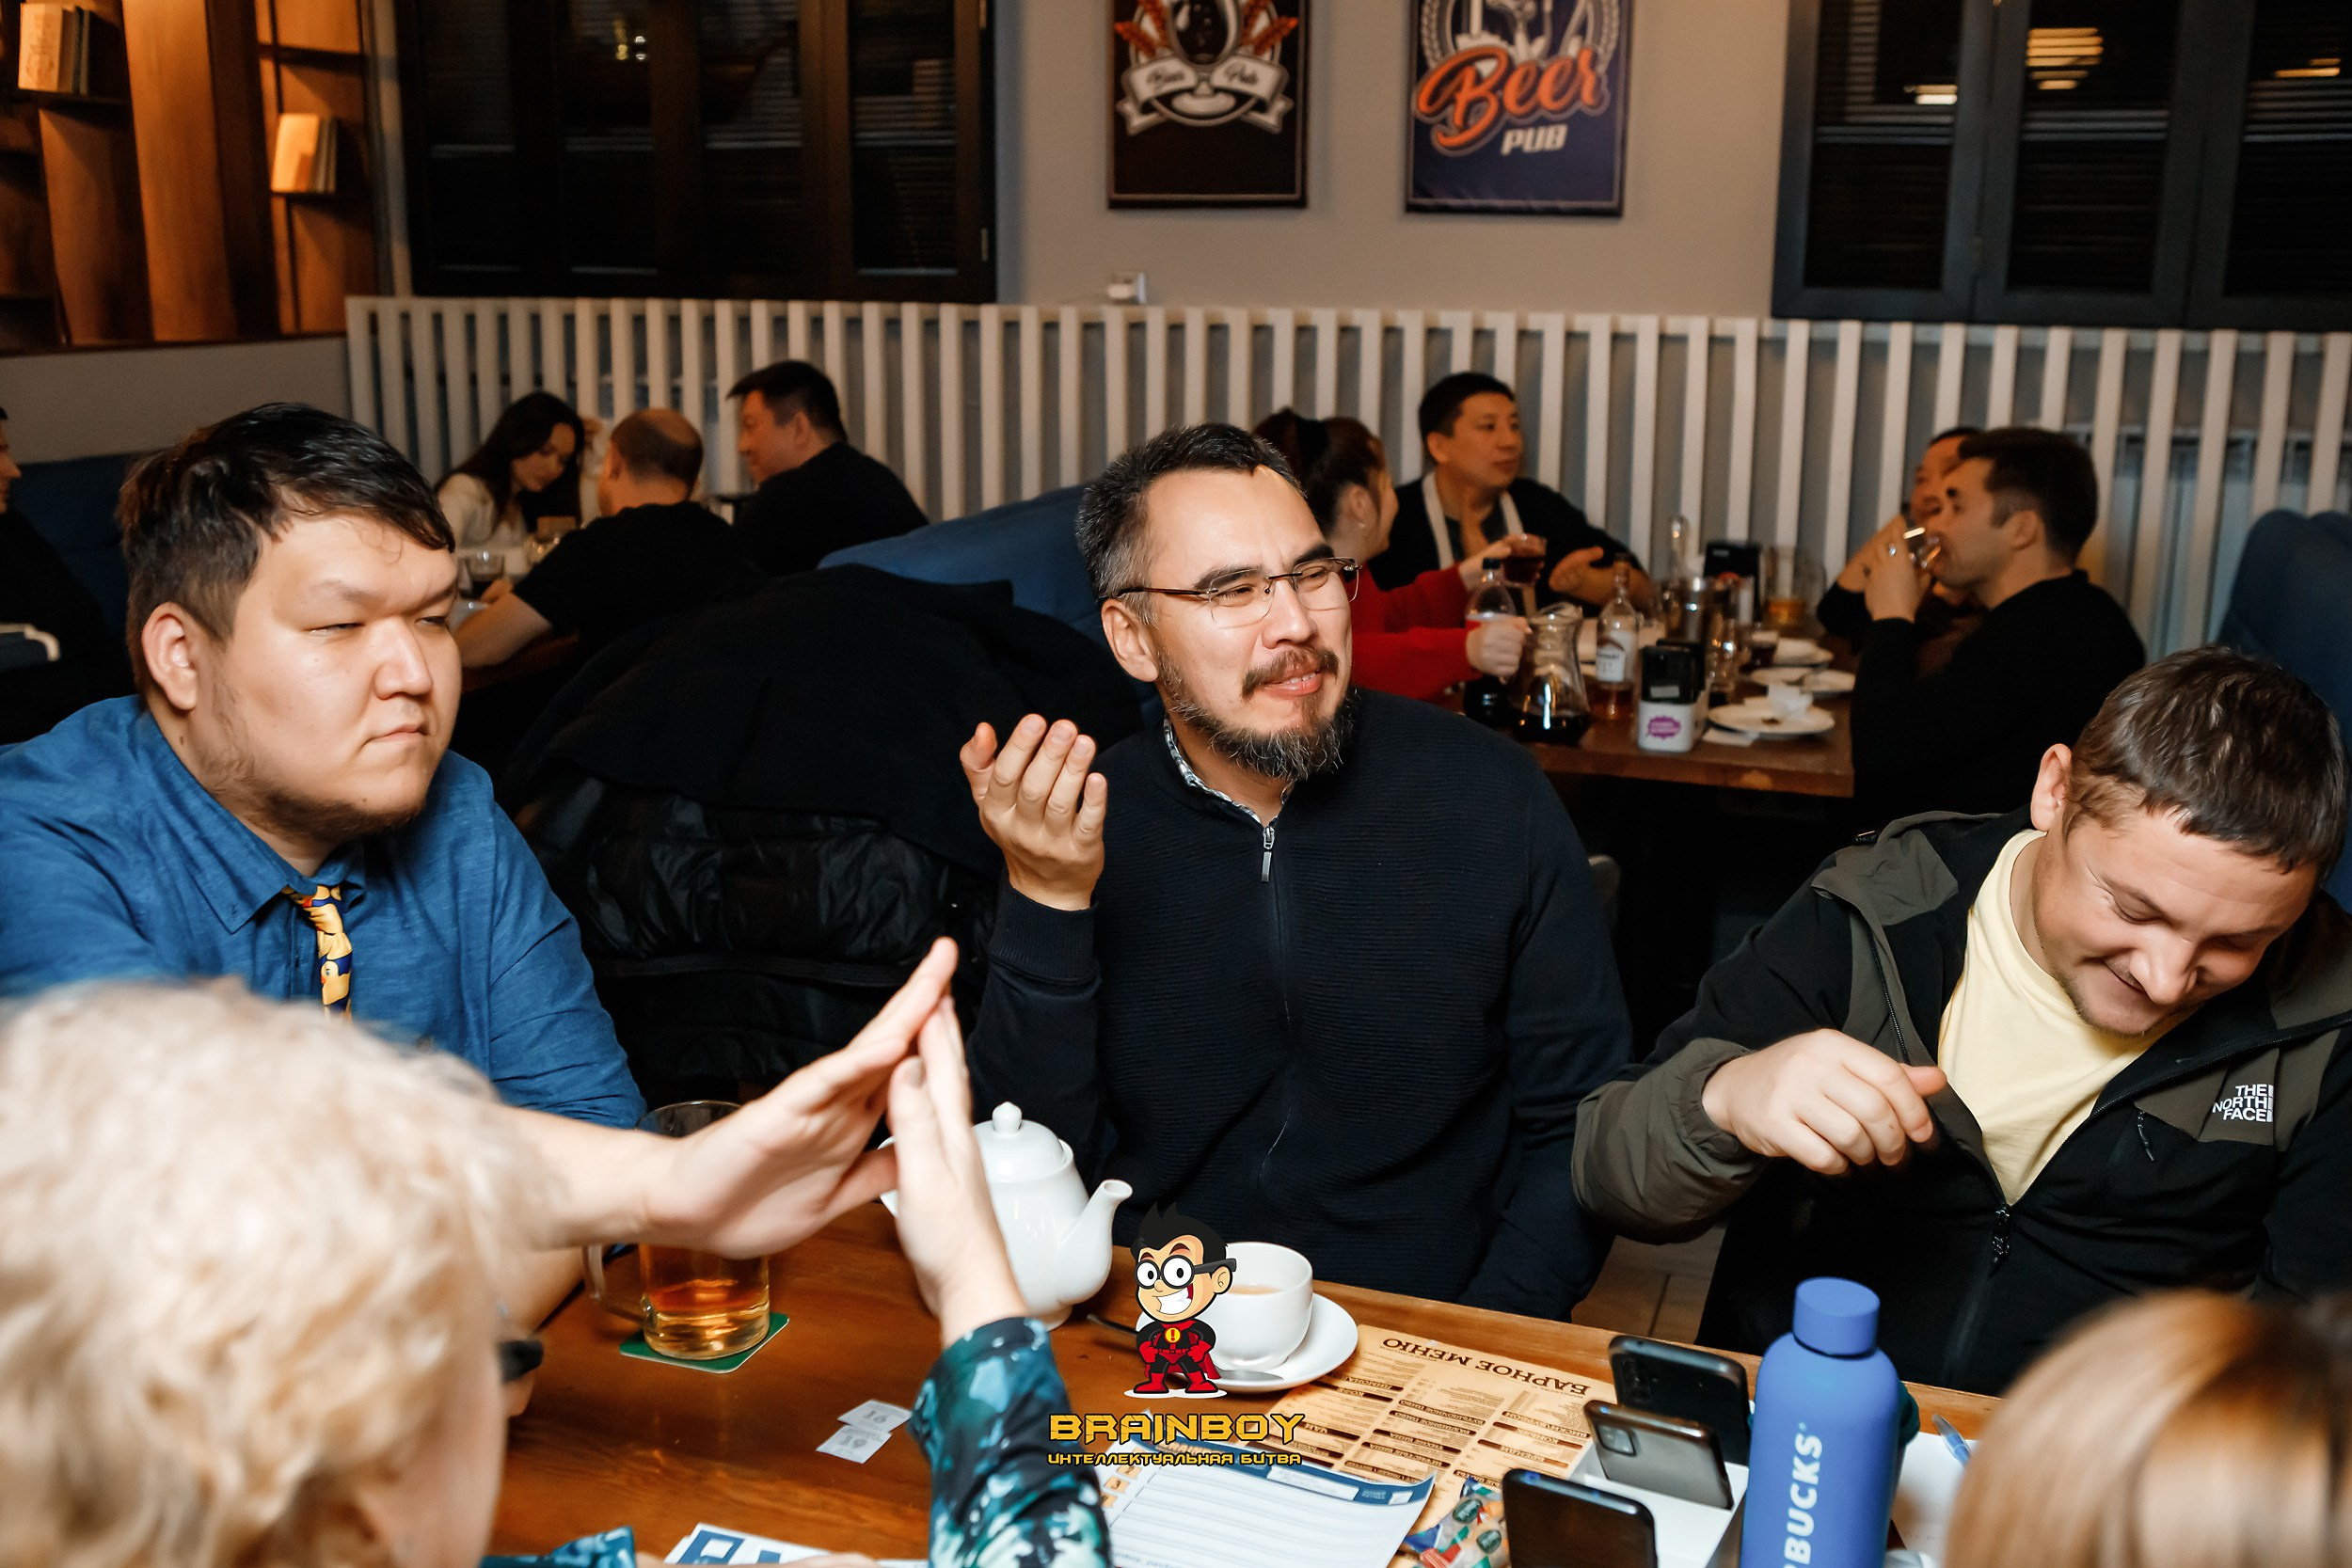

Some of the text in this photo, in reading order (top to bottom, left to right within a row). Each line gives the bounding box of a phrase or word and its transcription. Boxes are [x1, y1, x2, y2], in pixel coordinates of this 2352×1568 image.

[1418, 47, 1599, 150] Beer
[1502, 124, 1567, 155] PUB
[2212, 1096, 2268, 1113] NORTH
[2235, 1084, 2267, 1098] THE
[2223, 1107, 2267, 1122] FACE
[1382, 1338, 1472, 1366] МЕНЮ
[1475, 1360, 1591, 1396] БАРНОЕ
[1110, 1480, 1121, 1490] 3
[1783, 1432, 1823, 1568] BUCKS
